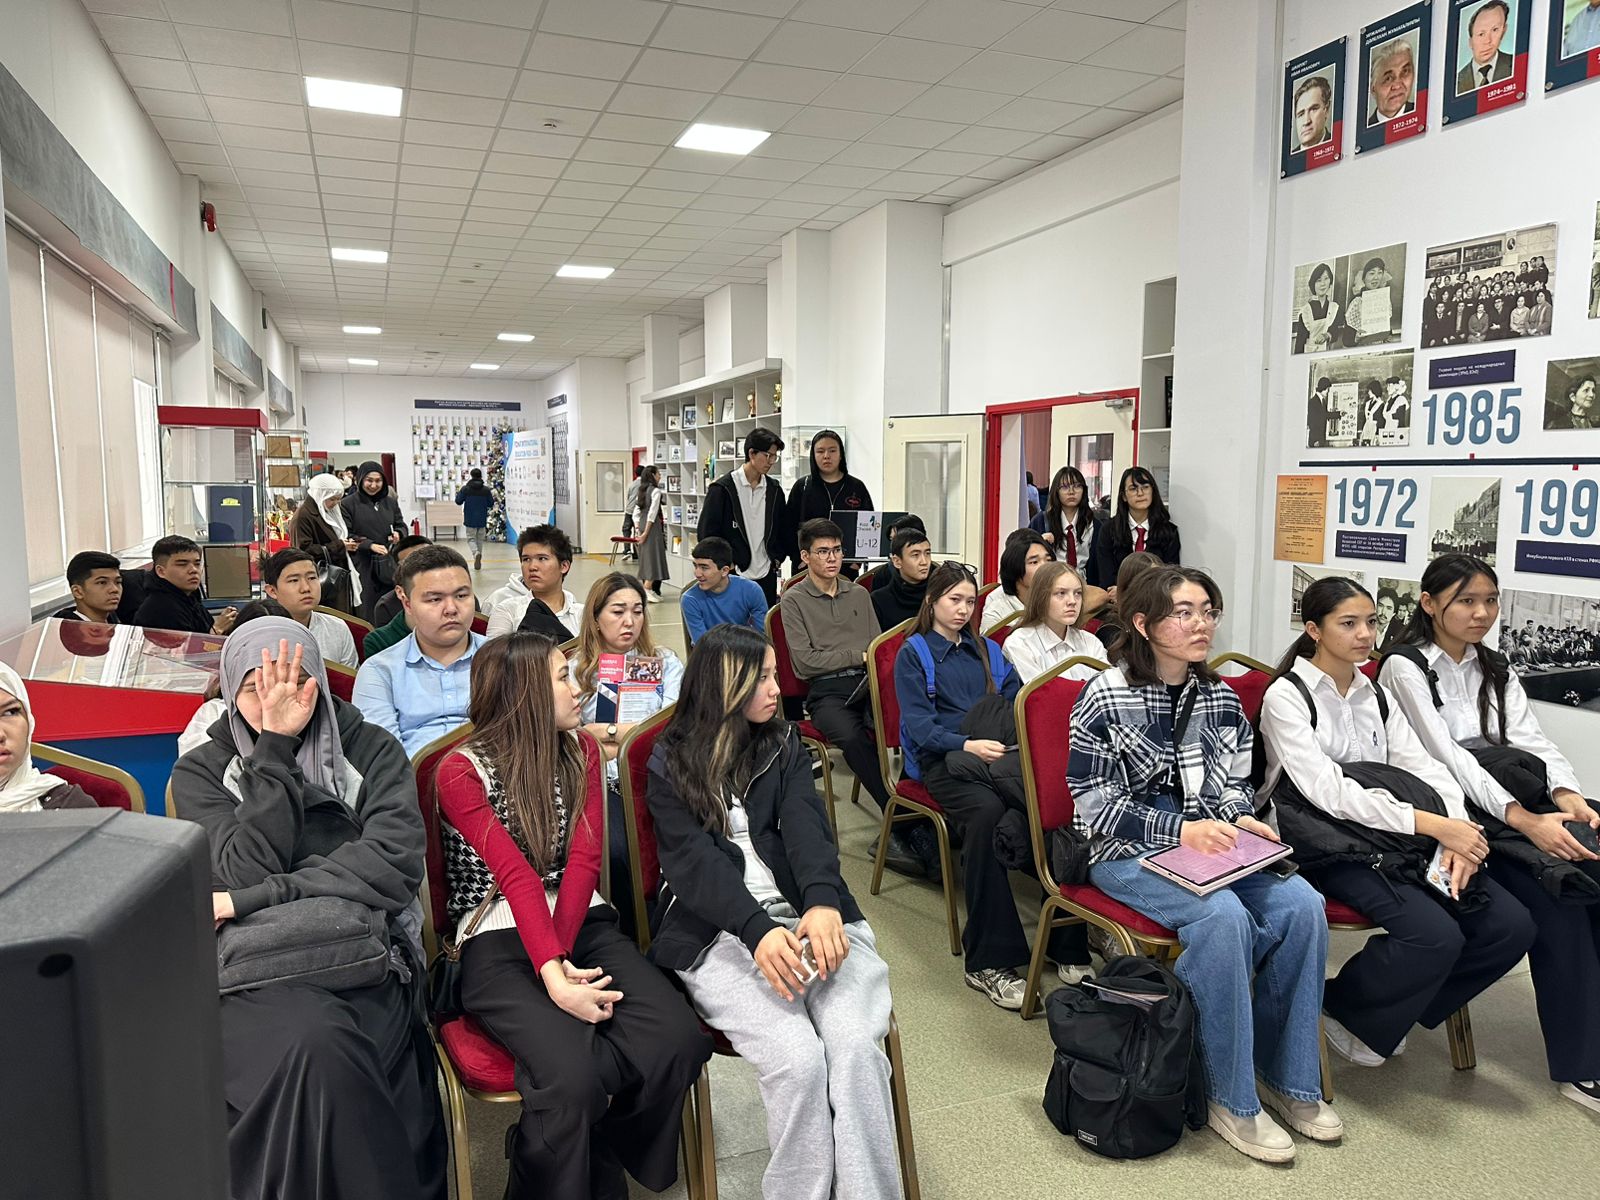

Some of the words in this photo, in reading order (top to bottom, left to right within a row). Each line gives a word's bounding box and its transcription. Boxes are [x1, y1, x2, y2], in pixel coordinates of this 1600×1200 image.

[1422, 387, 1522, 446] 1985
[1334, 478, 1418, 528] 1972
[856, 538, 878, 548] U-12
